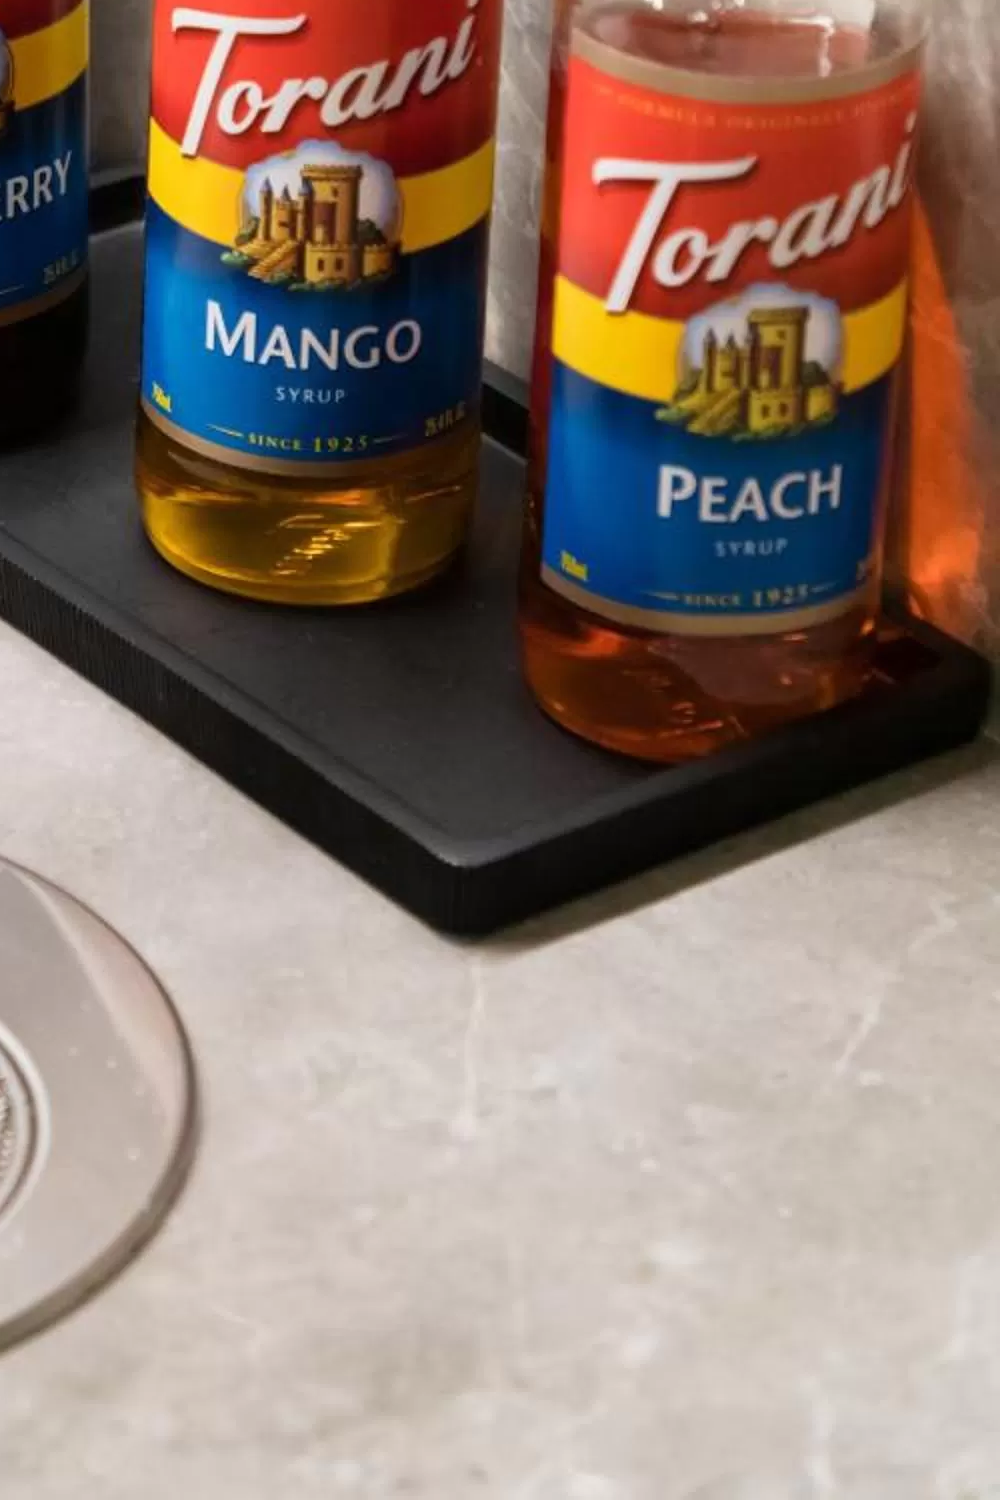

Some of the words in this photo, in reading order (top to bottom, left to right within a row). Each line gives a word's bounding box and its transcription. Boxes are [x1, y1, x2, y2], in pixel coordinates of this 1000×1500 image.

[591, 107, 917, 313] Torani
[204, 299, 422, 371] MANGO
[275, 386, 347, 404] SYRUP
[247, 432, 303, 451] SINCE
[313, 435, 370, 453] 1925
[656, 463, 844, 523] PEACH
[714, 538, 789, 557] SYRUP
